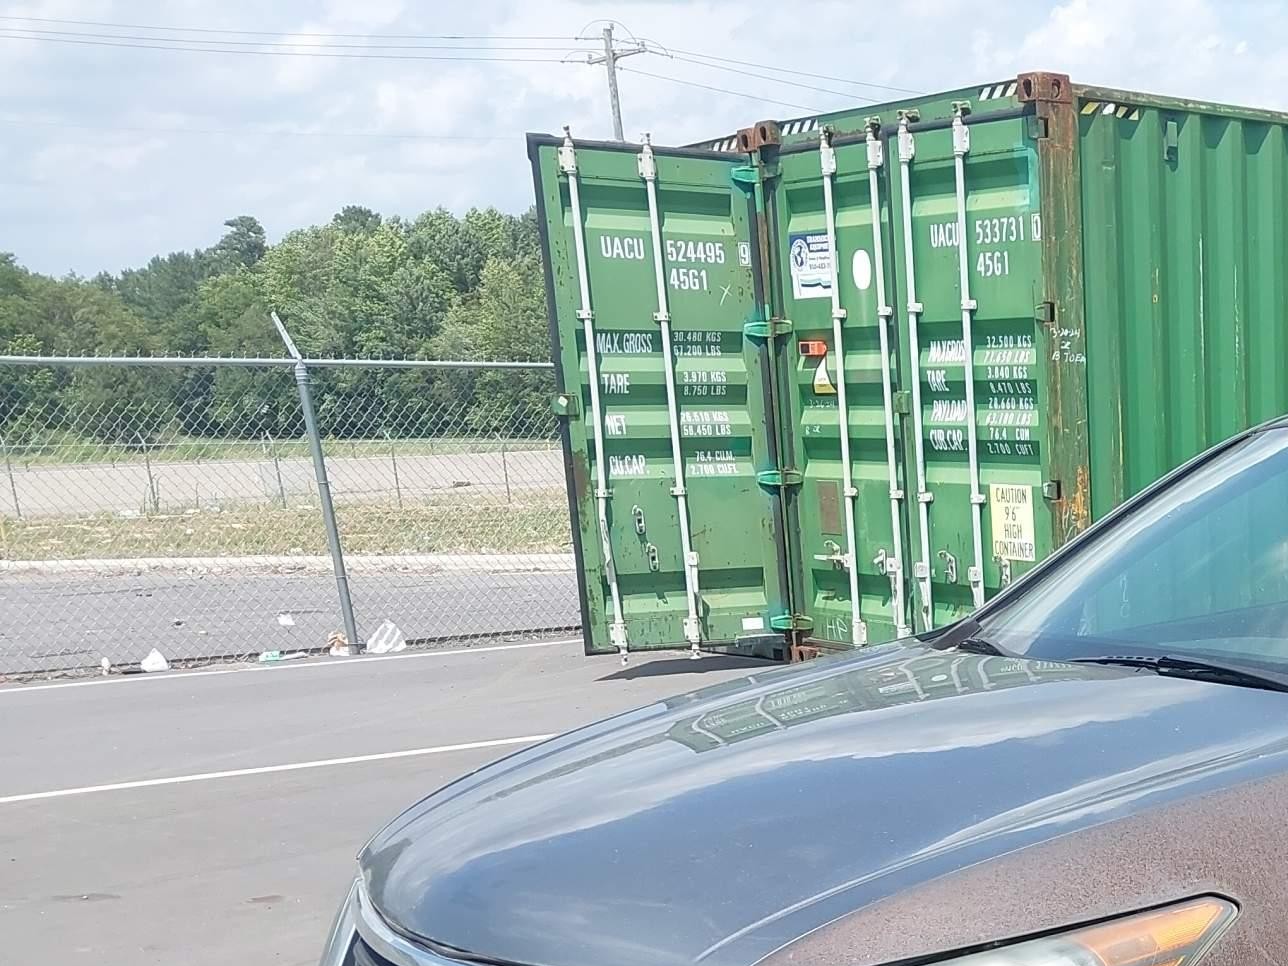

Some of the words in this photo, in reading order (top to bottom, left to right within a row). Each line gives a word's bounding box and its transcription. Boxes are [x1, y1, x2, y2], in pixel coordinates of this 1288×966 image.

[930, 223, 959, 247] UACU
[975, 216, 1024, 244] 533731
[600, 236, 645, 259] UACU
[666, 240, 725, 264] 524495
[739, 243, 750, 265] 9
[977, 251, 1009, 277] 45G1
[670, 268, 708, 291] 45G1
[706, 332, 721, 342] KGS
[986, 335, 1014, 348] 32.500
[1017, 335, 1032, 348] KGS
[706, 345, 721, 356] LBS
[1013, 351, 1030, 363] LBS
[602, 373, 630, 394] TARE
[683, 371, 707, 382] 3.970
[710, 372, 727, 382] KGS
[926, 370, 950, 392] TARE
[1013, 366, 1028, 379] KGS
[683, 386, 707, 396] 8.750
[711, 386, 727, 396] LBS
[1015, 382, 1032, 394] LBS
[931, 400, 968, 422] PAYLOAD
[1019, 397, 1034, 410] KGS
[605, 415, 627, 435] NET
[712, 411, 729, 422] KGS
[1015, 413, 1032, 425] LBS
[716, 424, 732, 436] LBS
[987, 442, 1011, 455] 2.700
[995, 487, 1027, 504] CAUTION
[1004, 523, 1023, 540] HIGH
[994, 540, 1034, 559] CONTAINER
